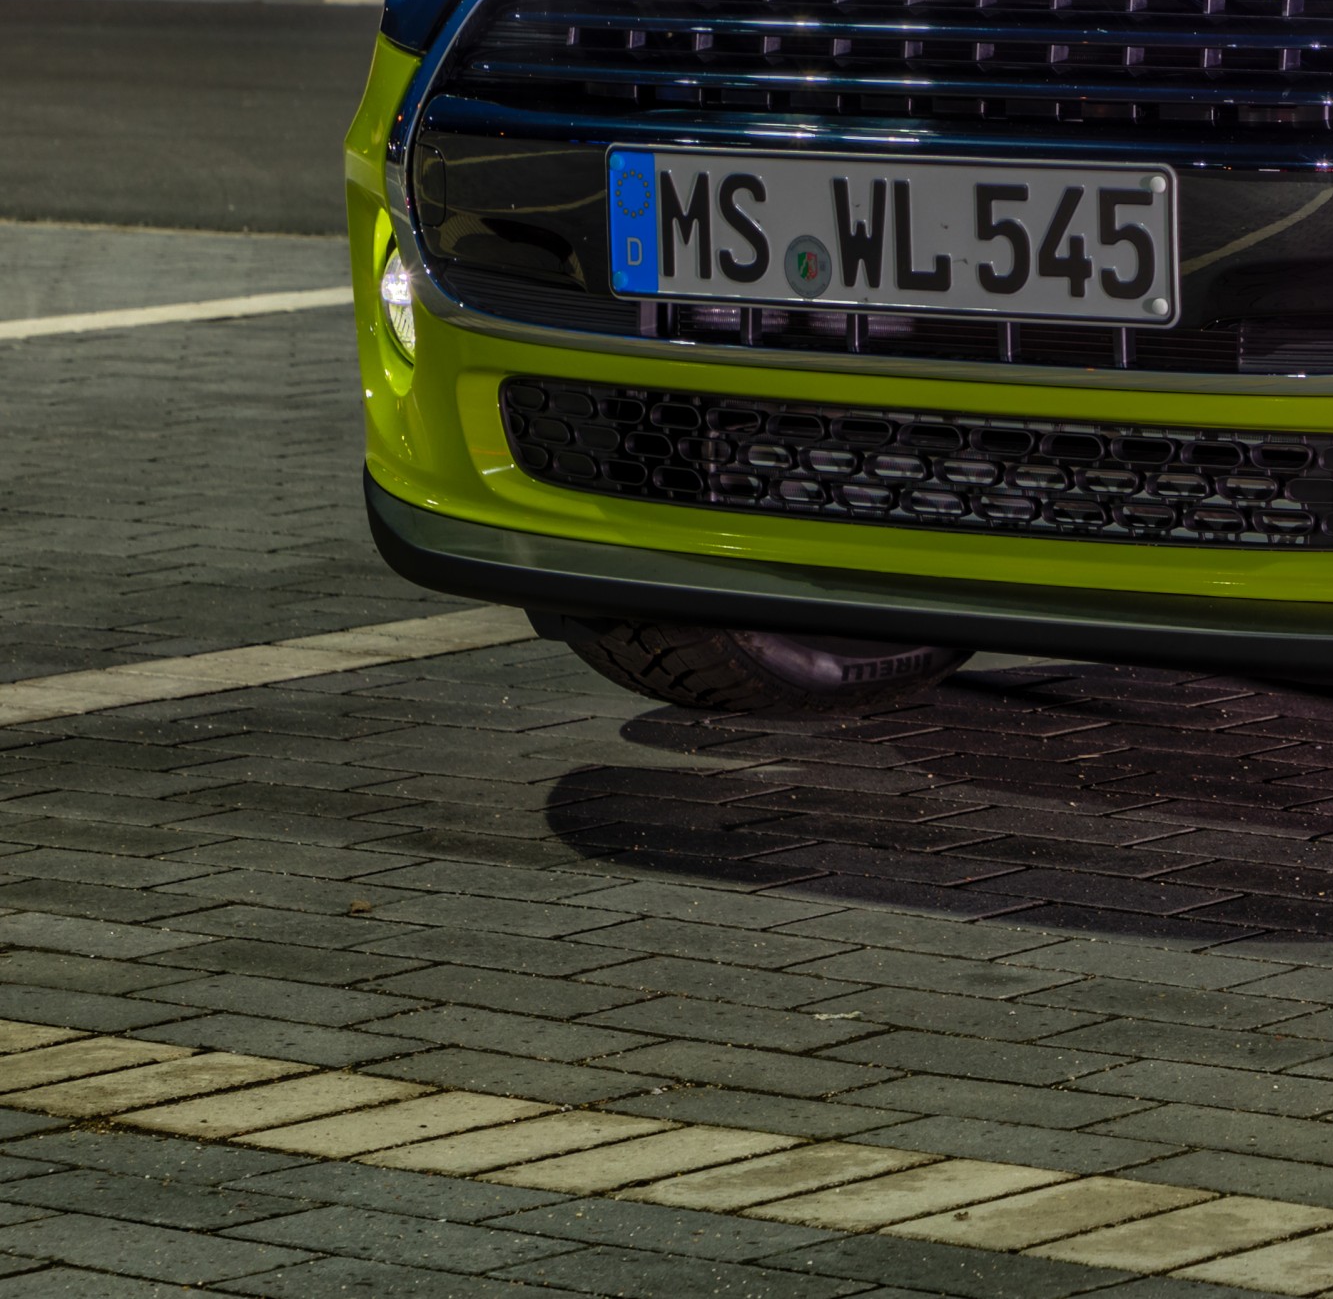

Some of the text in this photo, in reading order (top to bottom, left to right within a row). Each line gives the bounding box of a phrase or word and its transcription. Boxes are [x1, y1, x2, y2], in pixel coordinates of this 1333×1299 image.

[626, 236, 643, 266] D
[659, 170, 770, 283] MS
[832, 177, 953, 293] WL
[975, 183, 1156, 299] 545
